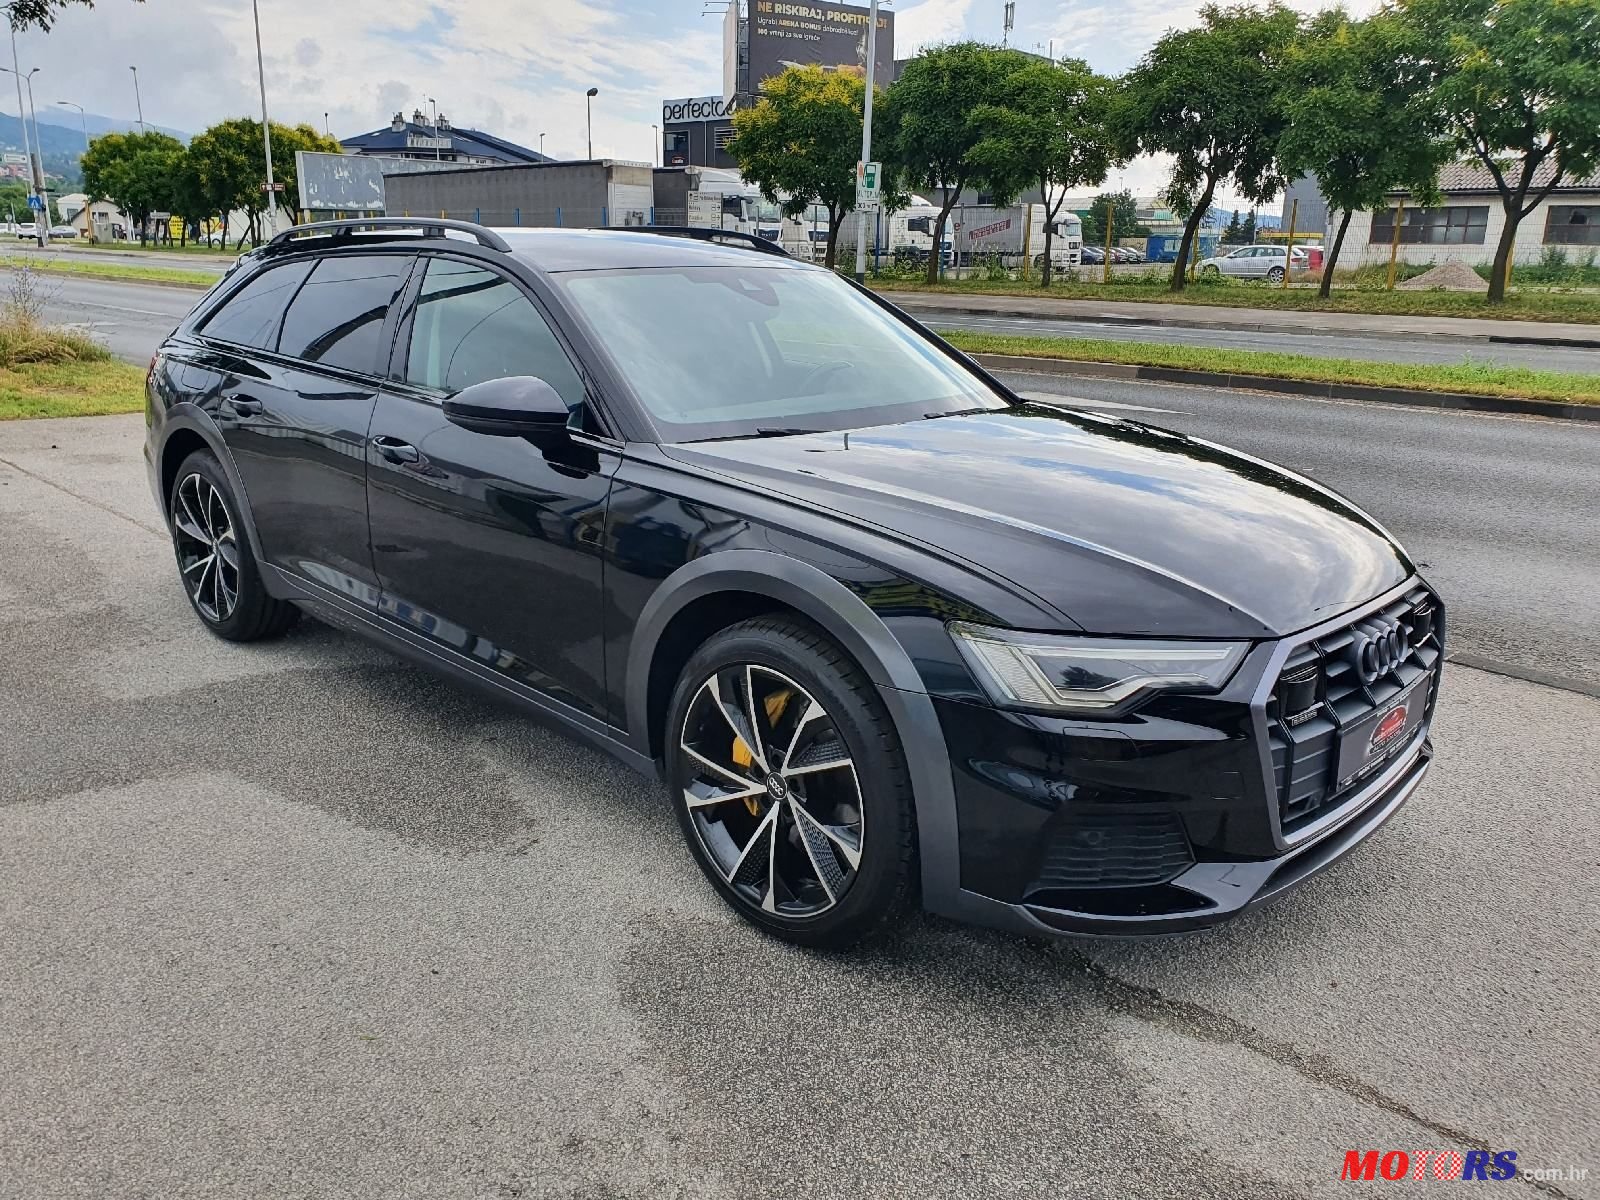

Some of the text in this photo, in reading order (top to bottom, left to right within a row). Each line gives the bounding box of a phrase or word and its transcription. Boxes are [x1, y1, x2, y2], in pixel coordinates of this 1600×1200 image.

[757, 1, 773, 13] NE
[774, 3, 825, 22] RISKIRAJ,
[757, 16, 778, 26] Ugrabi
[778, 19, 800, 28] ARENA
[800, 22, 822, 31] BONUS
